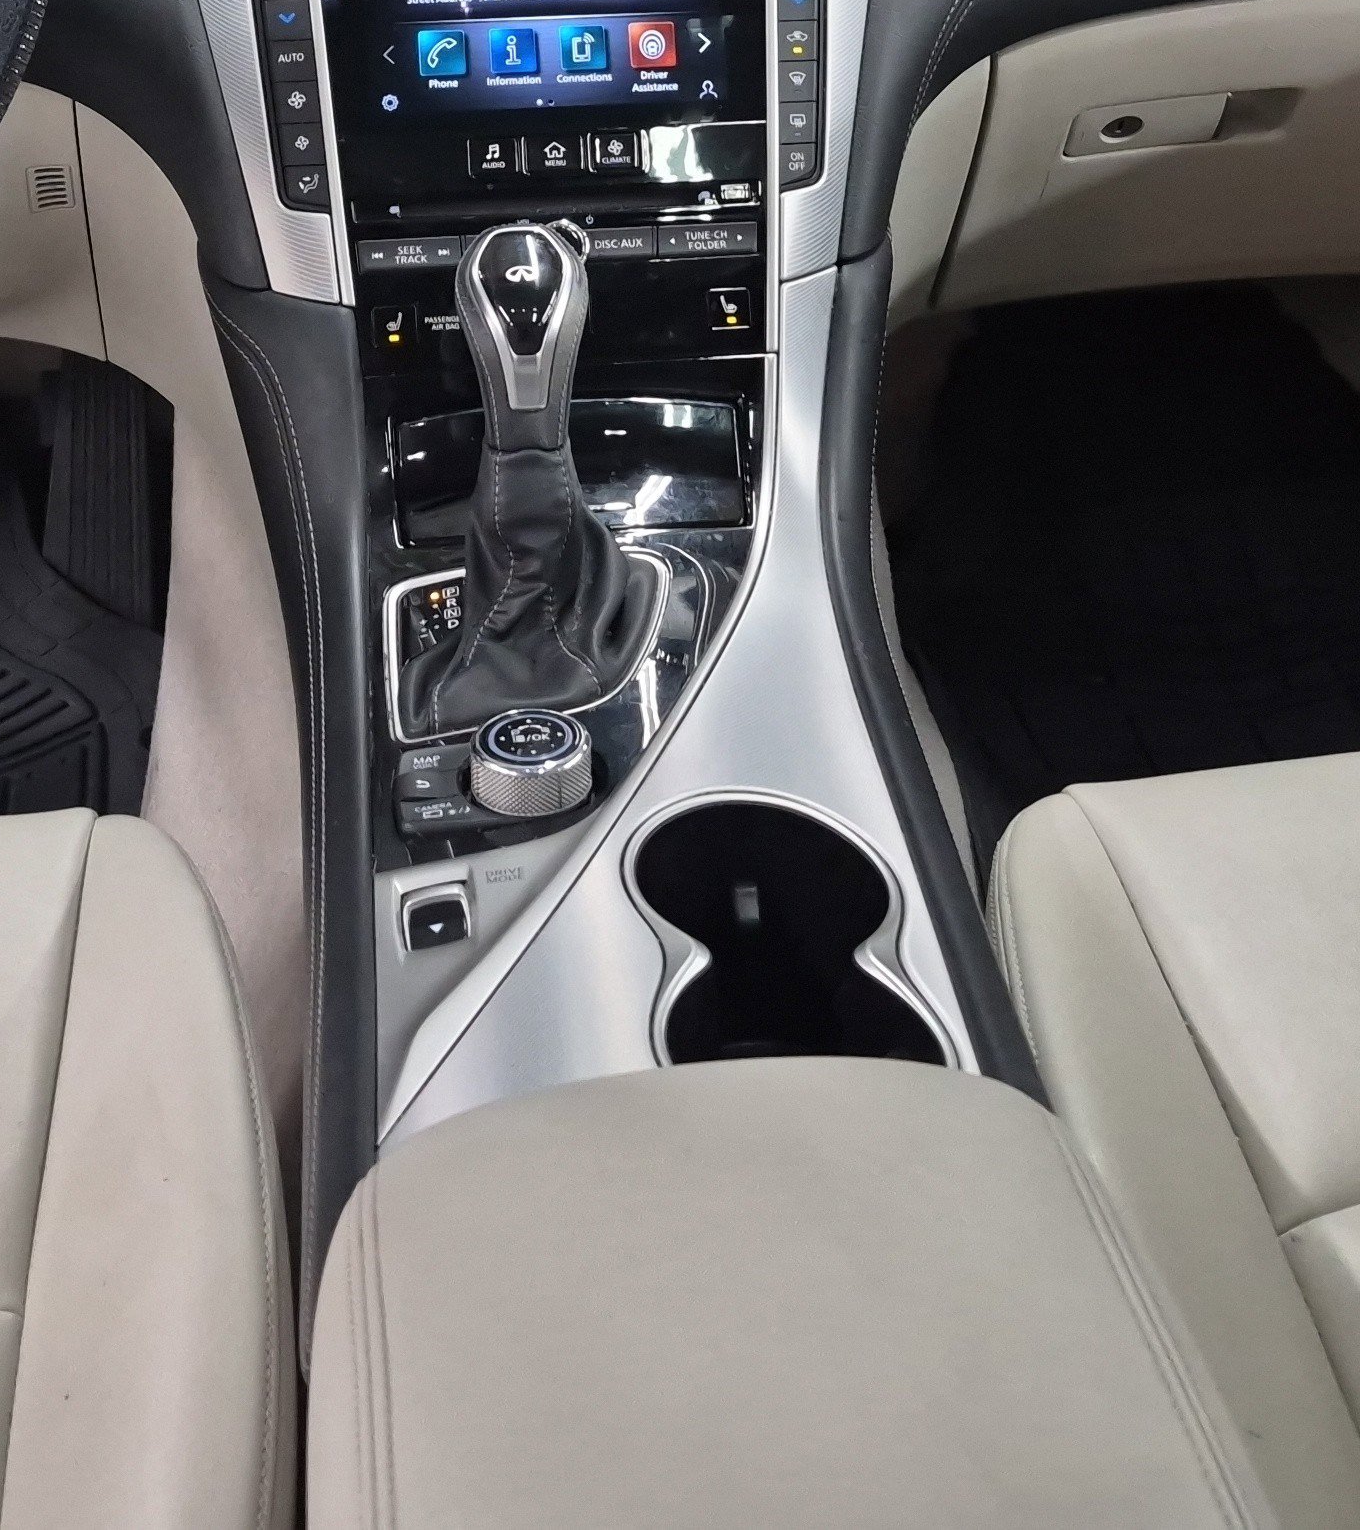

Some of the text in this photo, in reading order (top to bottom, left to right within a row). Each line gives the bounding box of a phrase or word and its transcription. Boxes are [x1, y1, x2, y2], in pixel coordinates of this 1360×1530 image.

[277, 52, 305, 63] AUTO
[556, 72, 613, 84] Connections
[640, 70, 669, 80] Driver
[428, 78, 459, 89] Phone
[486, 75, 542, 86] Information
[632, 81, 679, 93] Assistance
[601, 155, 632, 165] CLIMATE
[790, 152, 805, 161] ON
[481, 161, 506, 169] AUDIO
[544, 159, 566, 167] MENU
[788, 161, 806, 171] OFF
[397, 245, 423, 255] SEEK
[688, 240, 727, 250] FOLDER
[395, 254, 427, 264] TRACK
[431, 322, 460, 331] AIR BAG
[446, 598, 458, 608] R
[447, 619, 460, 629] D
[413, 754, 441, 765] MAP
[414, 802, 453, 813] CAMERA
